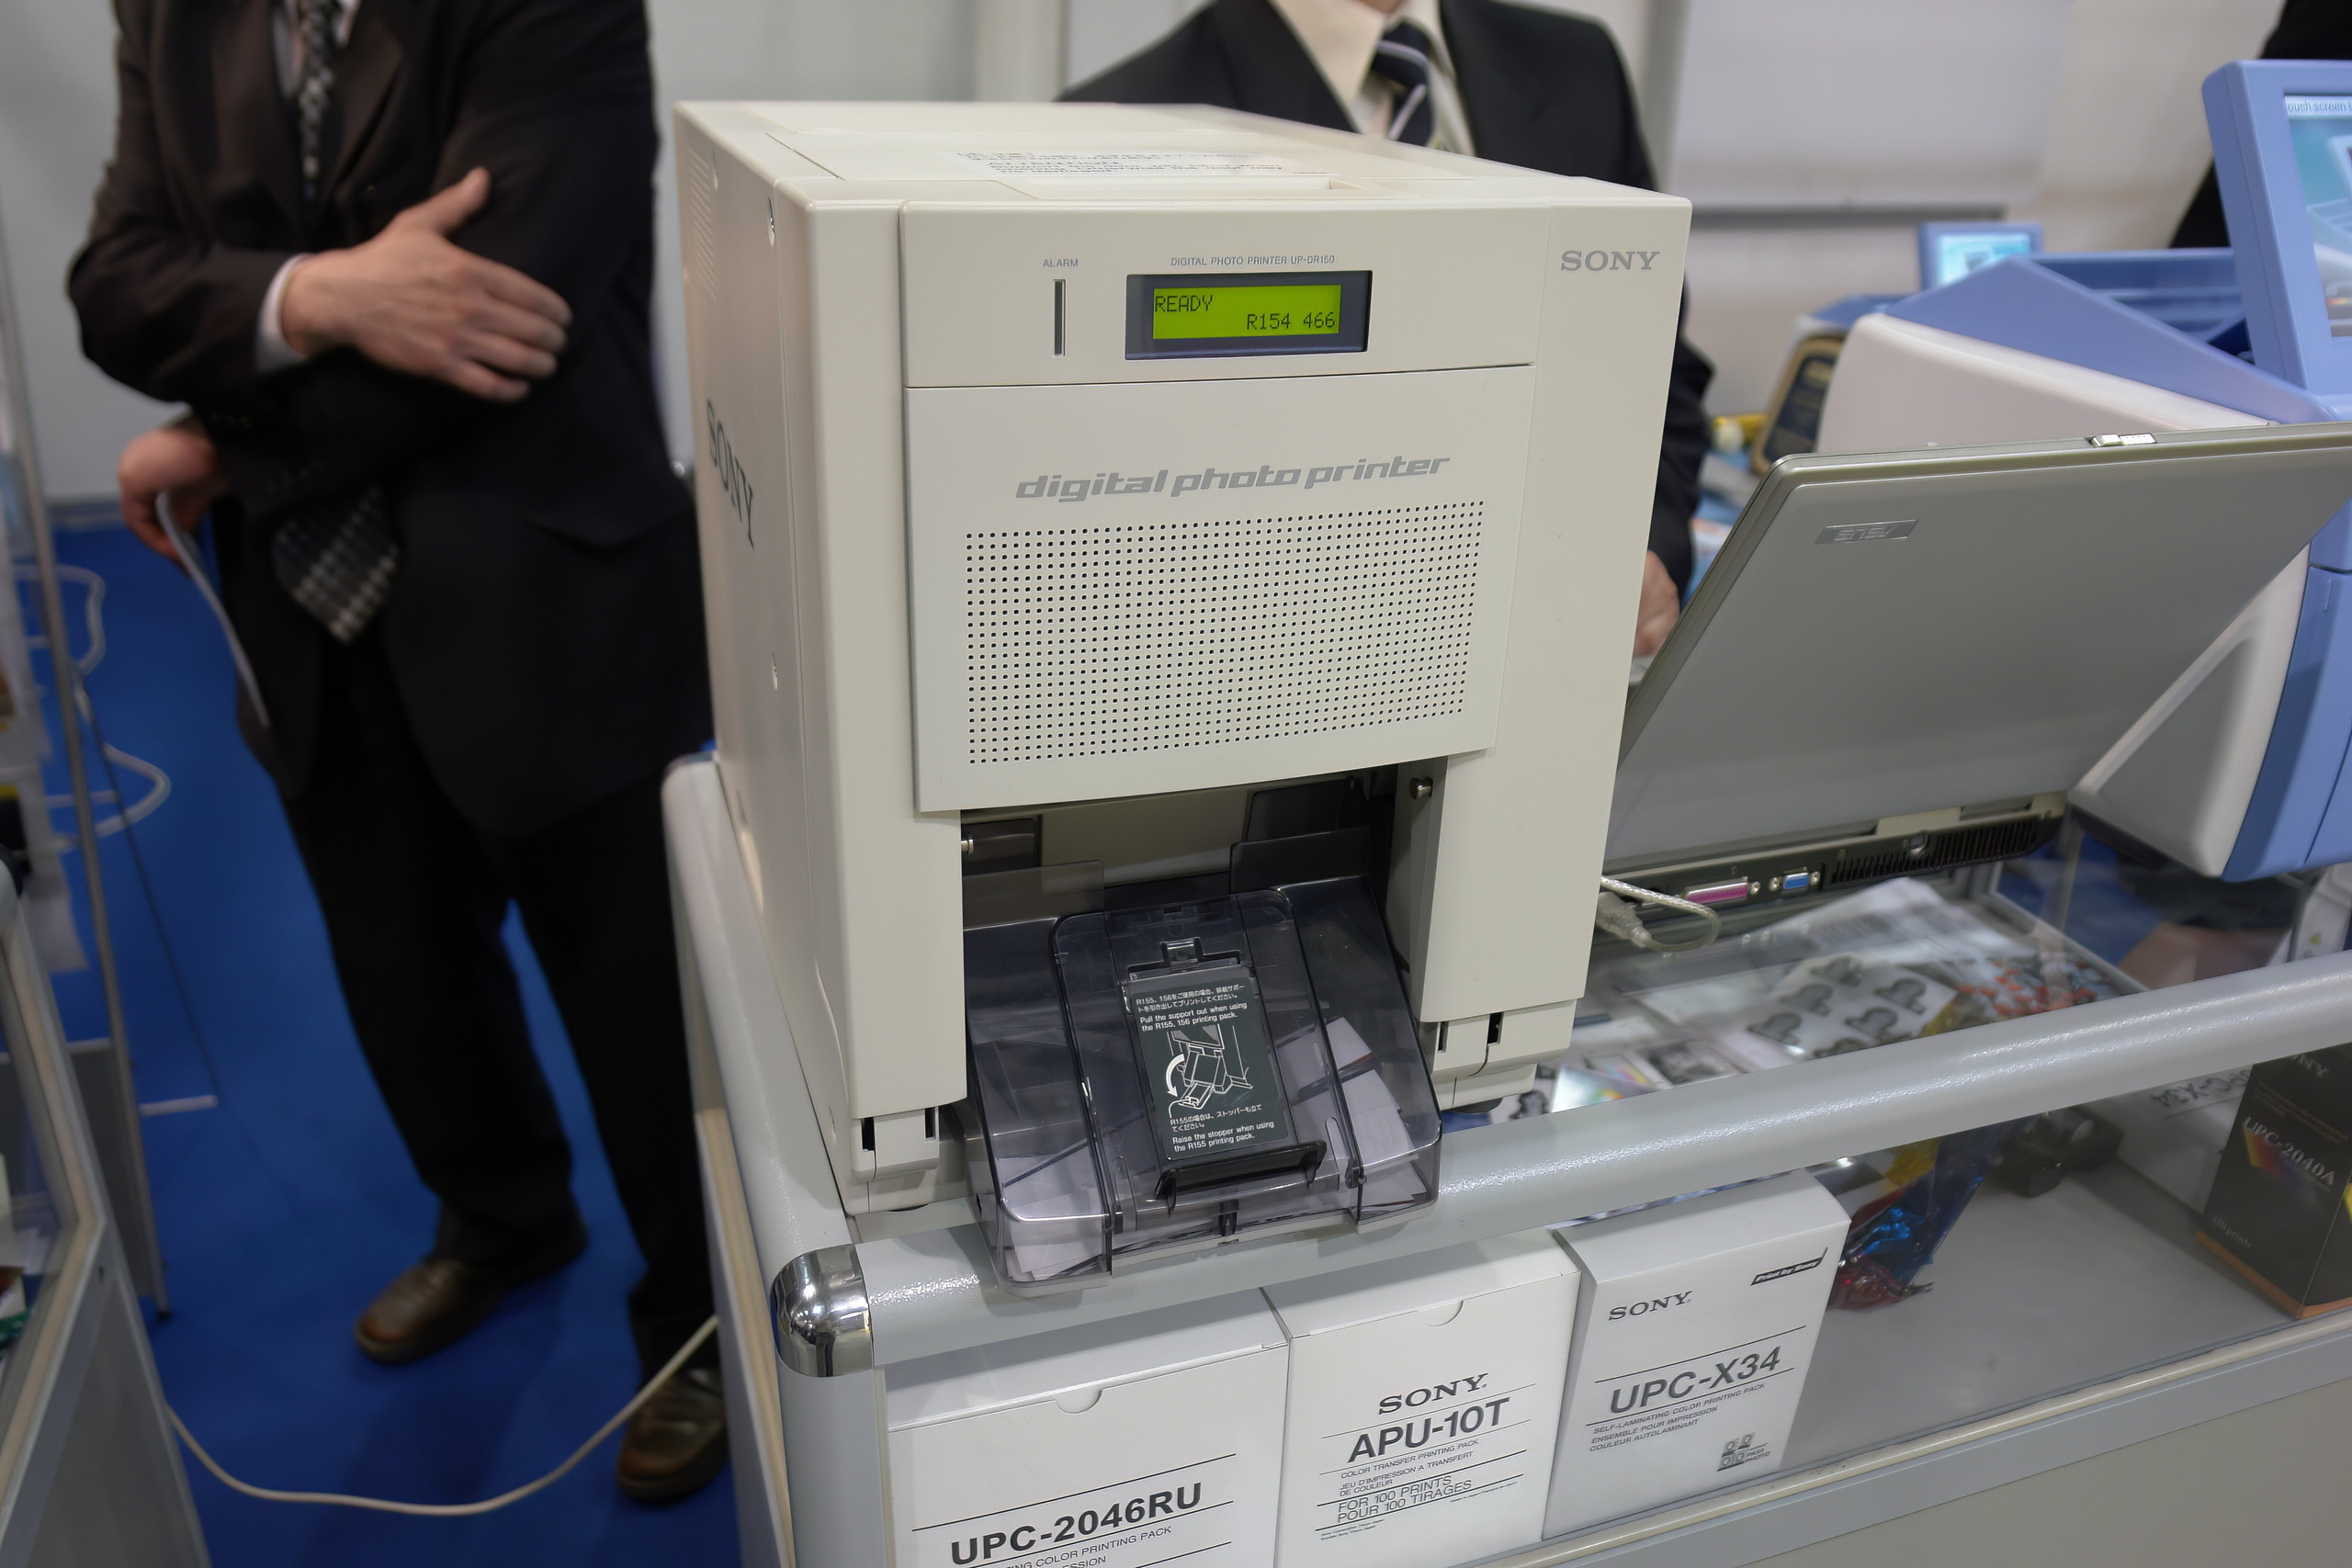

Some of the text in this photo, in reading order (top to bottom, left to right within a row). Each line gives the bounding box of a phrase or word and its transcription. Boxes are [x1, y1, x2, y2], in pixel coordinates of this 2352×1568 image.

[1043, 258, 1079, 267] ALARM
[1170, 255, 1335, 266] DIGITAL PHOTO PRINTER UP-DR150
[1561, 250, 1660, 271] SONY
[1154, 295, 1214, 312] READY
[1247, 312, 1336, 331] R154 466
[707, 398, 754, 549] SONY
[1015, 457, 1451, 502] digital photo printer
[1168, 1009, 1194, 1021] support
[1196, 1007, 1208, 1015] out
[1210, 1004, 1227, 1013] when
[1229, 1002, 1248, 1010] using
[1177, 1018, 1191, 1026] 156
[1193, 1014, 1217, 1024] printing
[1188, 1141, 1206, 1150] R155
[1208, 1137, 1234, 1147] printing
[1207, 1128, 1234, 1139] stopper
[1236, 1124, 1254, 1133] when
[1256, 1122, 1274, 1130] using
[1609, 1291, 1692, 1321] SONY
[1378, 1372, 1488, 1415] SONY
[1610, 1346, 1781, 1414] UPC-X34
[1591, 1405, 1718, 1444] ENSEMBLE POUR IMPRESSION
[1594, 1382, 1765, 1434] SELF-LAMINATING COLOR PRINTING PACK
[1348, 1397, 1510, 1463] APU-10T
[1589, 1418, 1699, 1452] COULEUR AUTOLAMINANT
[1340, 1438, 1478, 1479] COLOR TRANSFER PRINTING PACK
[1340, 1482, 1356, 1491] JEU
[1358, 1467, 1416, 1485] D'IMPRESSION
[1428, 1450, 1474, 1468] TRANSFERT
[1338, 1505, 1380, 1523] POUR
[1385, 1497, 1407, 1512] 100
[1411, 1479, 1473, 1504] TIRAGES
[1339, 1497, 1369, 1513] FOR
[1374, 1490, 1396, 1503] 100
[1400, 1475, 1452, 1498] PRINTS
[1340, 1479, 1394, 1497] DE COULEUR
[951, 1482, 1202, 1565] UPC-2046RU
[1036, 1551, 1078, 1566] COLOR
[1082, 1535, 1137, 1556] PRINTING
[1140, 1525, 1171, 1540] PACK
